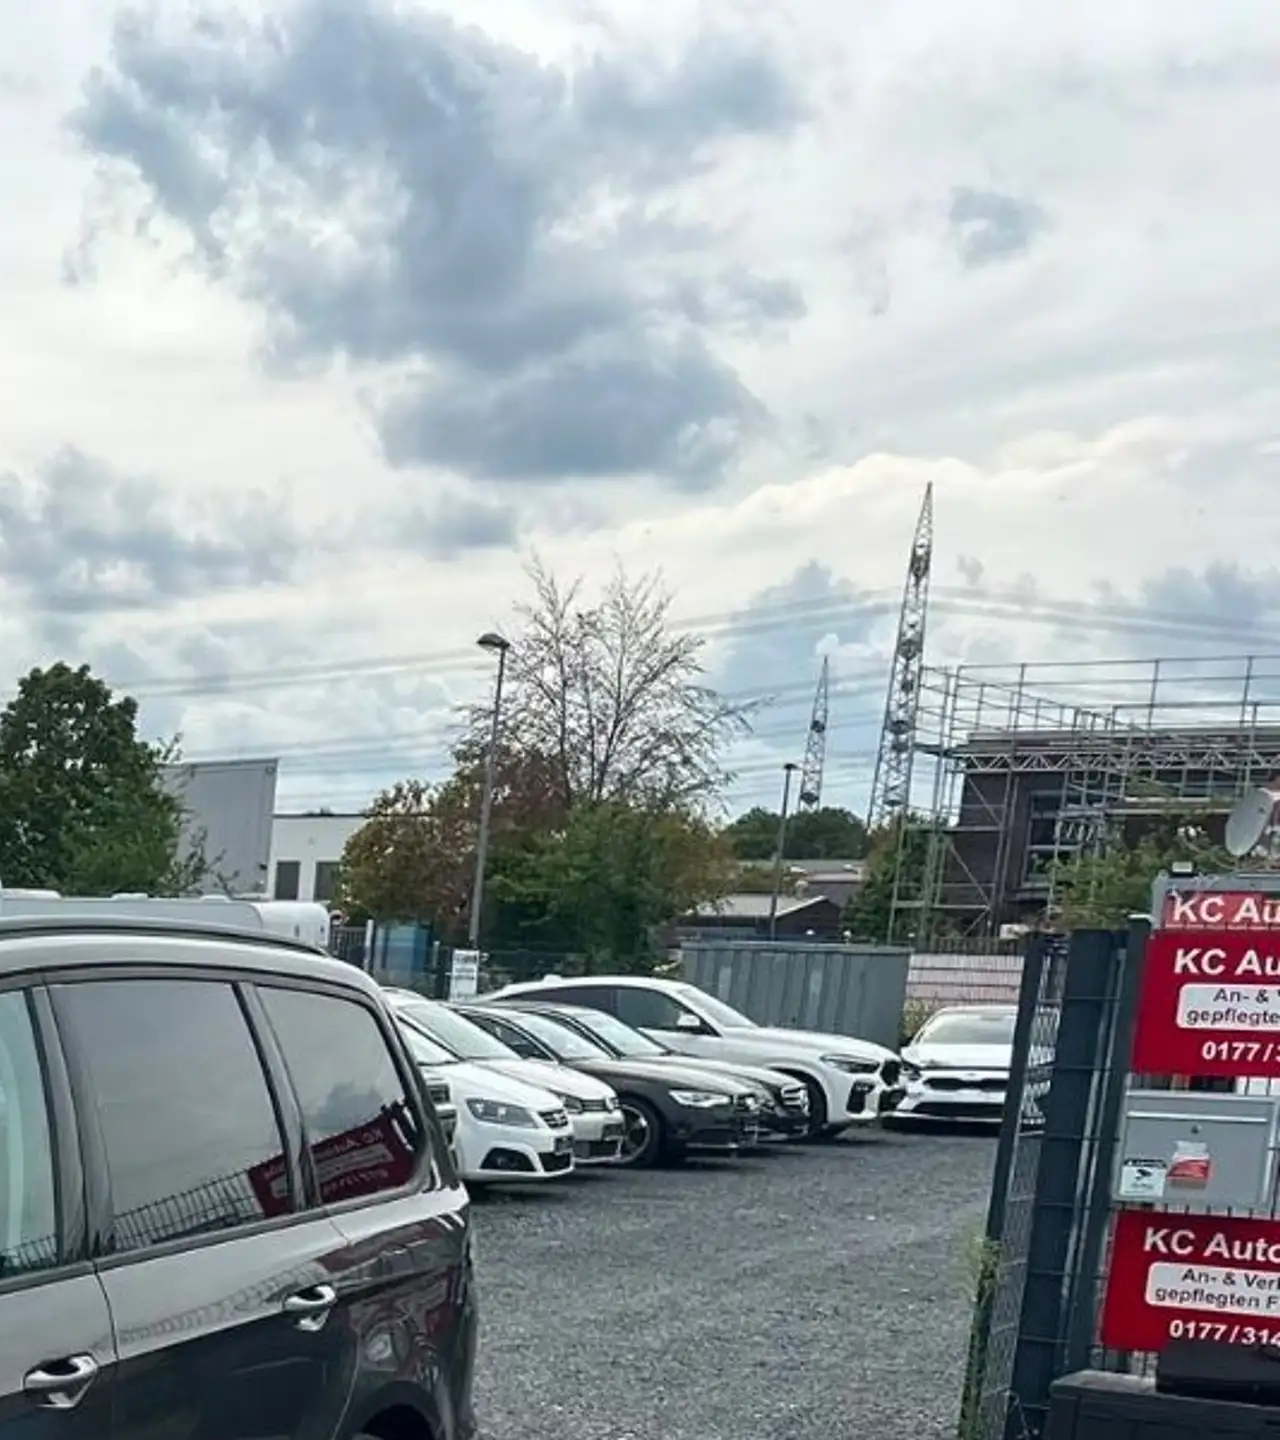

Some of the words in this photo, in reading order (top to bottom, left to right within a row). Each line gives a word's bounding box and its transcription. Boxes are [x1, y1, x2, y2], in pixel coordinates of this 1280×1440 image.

[1172, 891, 1225, 923] KC
[1174, 947, 1226, 975] KC
[1143, 1226, 1196, 1256] KC
[1181, 1267, 1217, 1285] An-
[1222, 1271, 1237, 1287] &
[1155, 1286, 1261, 1309] gepflegten
